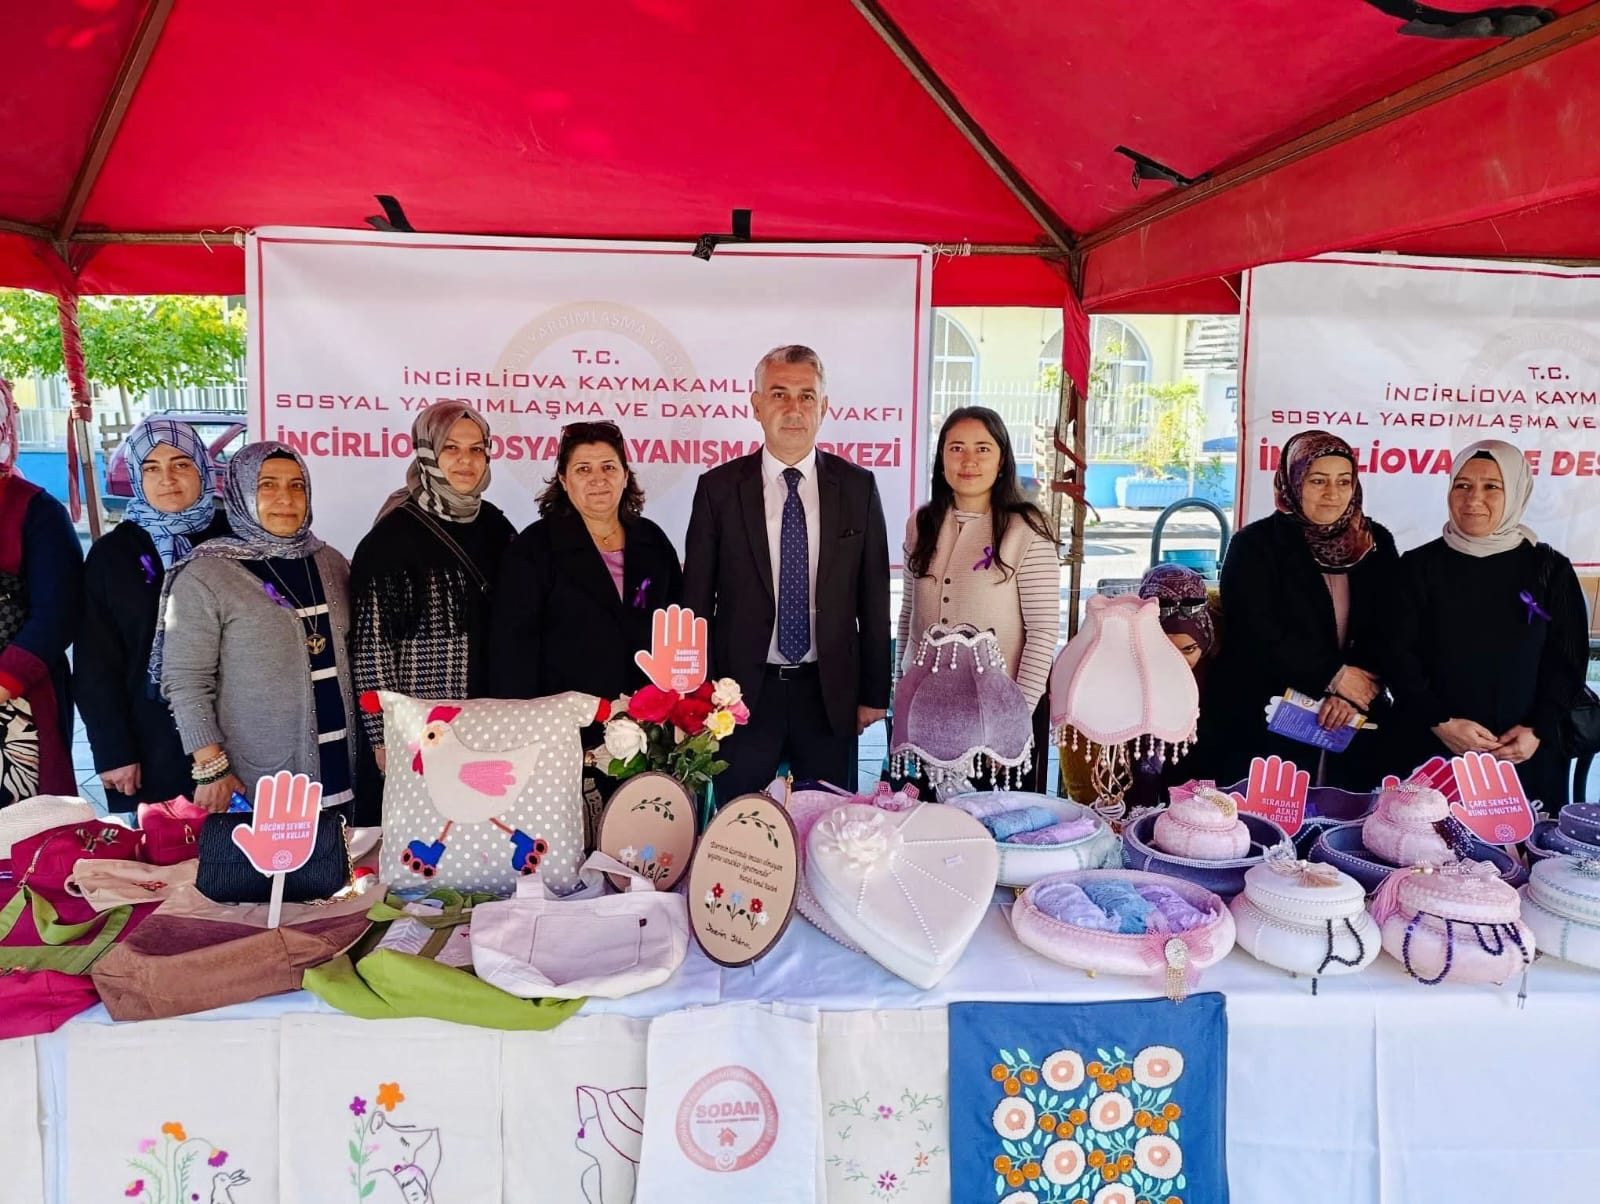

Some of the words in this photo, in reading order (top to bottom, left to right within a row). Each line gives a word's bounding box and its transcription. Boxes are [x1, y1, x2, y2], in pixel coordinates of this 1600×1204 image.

[572, 349, 620, 365] T.C.
[403, 365, 566, 389] İNCİRLİOVA
[579, 375, 753, 393] KAYMAKAMLI
[1528, 366, 1569, 380] T.C.
[1385, 382, 1527, 404] İNCİRLİOVA
[1535, 390, 1600, 405] KAYM
[276, 393, 390, 411] SOSYAL
[399, 396, 604, 420] YAIMLAŞMA
[615, 402, 648, 417] VE
[661, 403, 749, 419] DAYAN
[828, 407, 903, 422] VAKFI
[1271, 410, 1369, 426] SOSYAL
[1379, 412, 1559, 434] YARDIMLAŞMA
[1567, 415, 1597, 429] VE
[277, 425, 413, 459] İNCİRLİO
[490, 435, 560, 461] OSYA
[624, 438, 762, 469] YANIŞM
[817, 437, 901, 467] KEZİ
[1259, 437, 1452, 475] İLİOVA
[695, 1100, 760, 1118] SODAM
